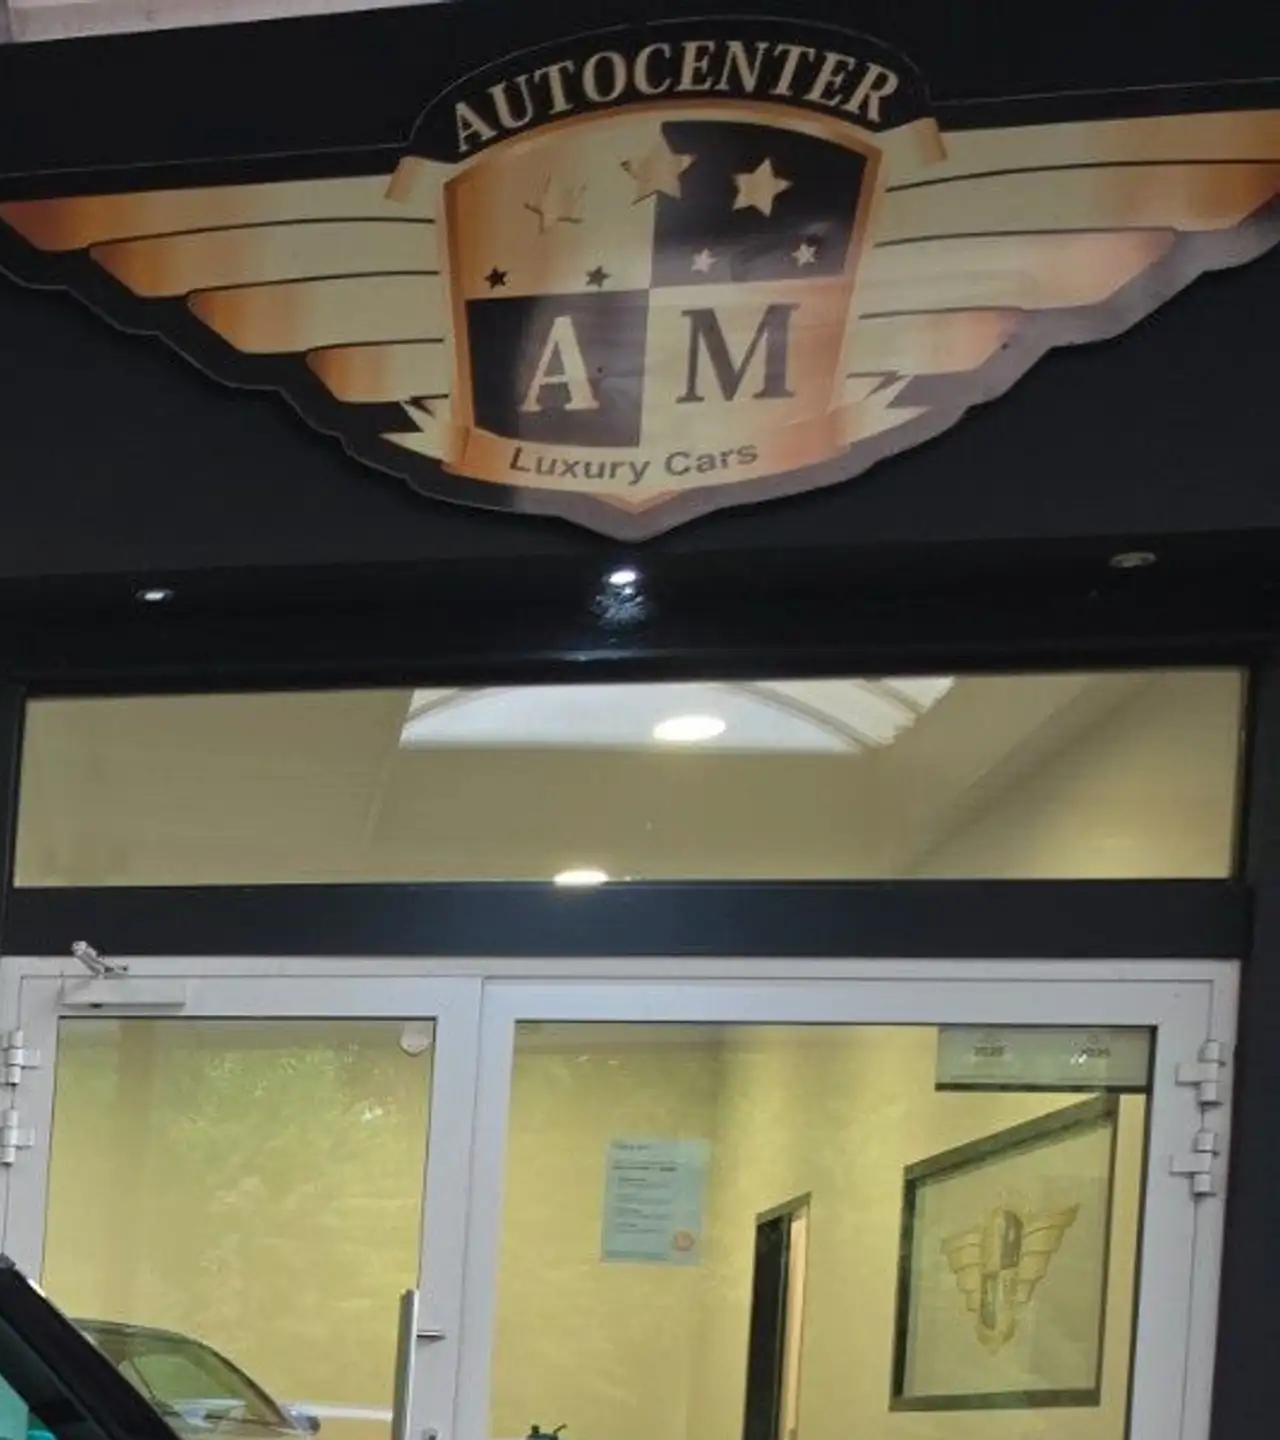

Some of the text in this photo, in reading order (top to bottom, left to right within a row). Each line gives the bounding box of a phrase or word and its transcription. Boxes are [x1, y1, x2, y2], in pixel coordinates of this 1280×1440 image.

[454, 40, 899, 153] AUTOCENTER
[509, 440, 759, 486] Luxury Cars
